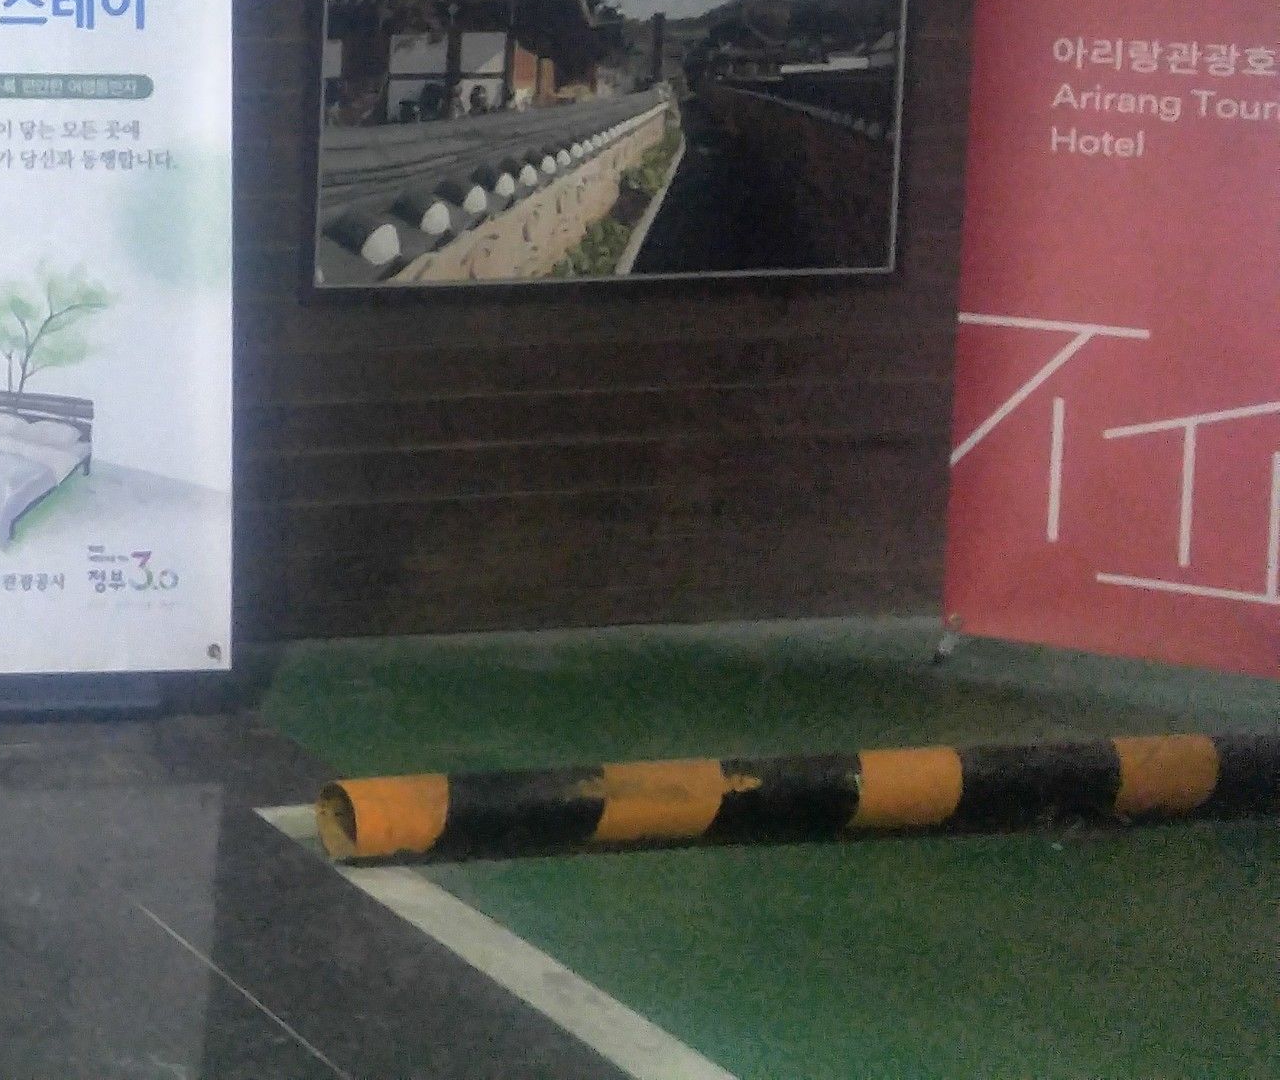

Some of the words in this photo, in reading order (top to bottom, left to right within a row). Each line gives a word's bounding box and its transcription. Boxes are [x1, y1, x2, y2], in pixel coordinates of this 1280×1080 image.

[1051, 82, 1183, 123] Arirang
[1050, 126, 1145, 158] Hotel
[20, 148, 74, 170] 당신과
